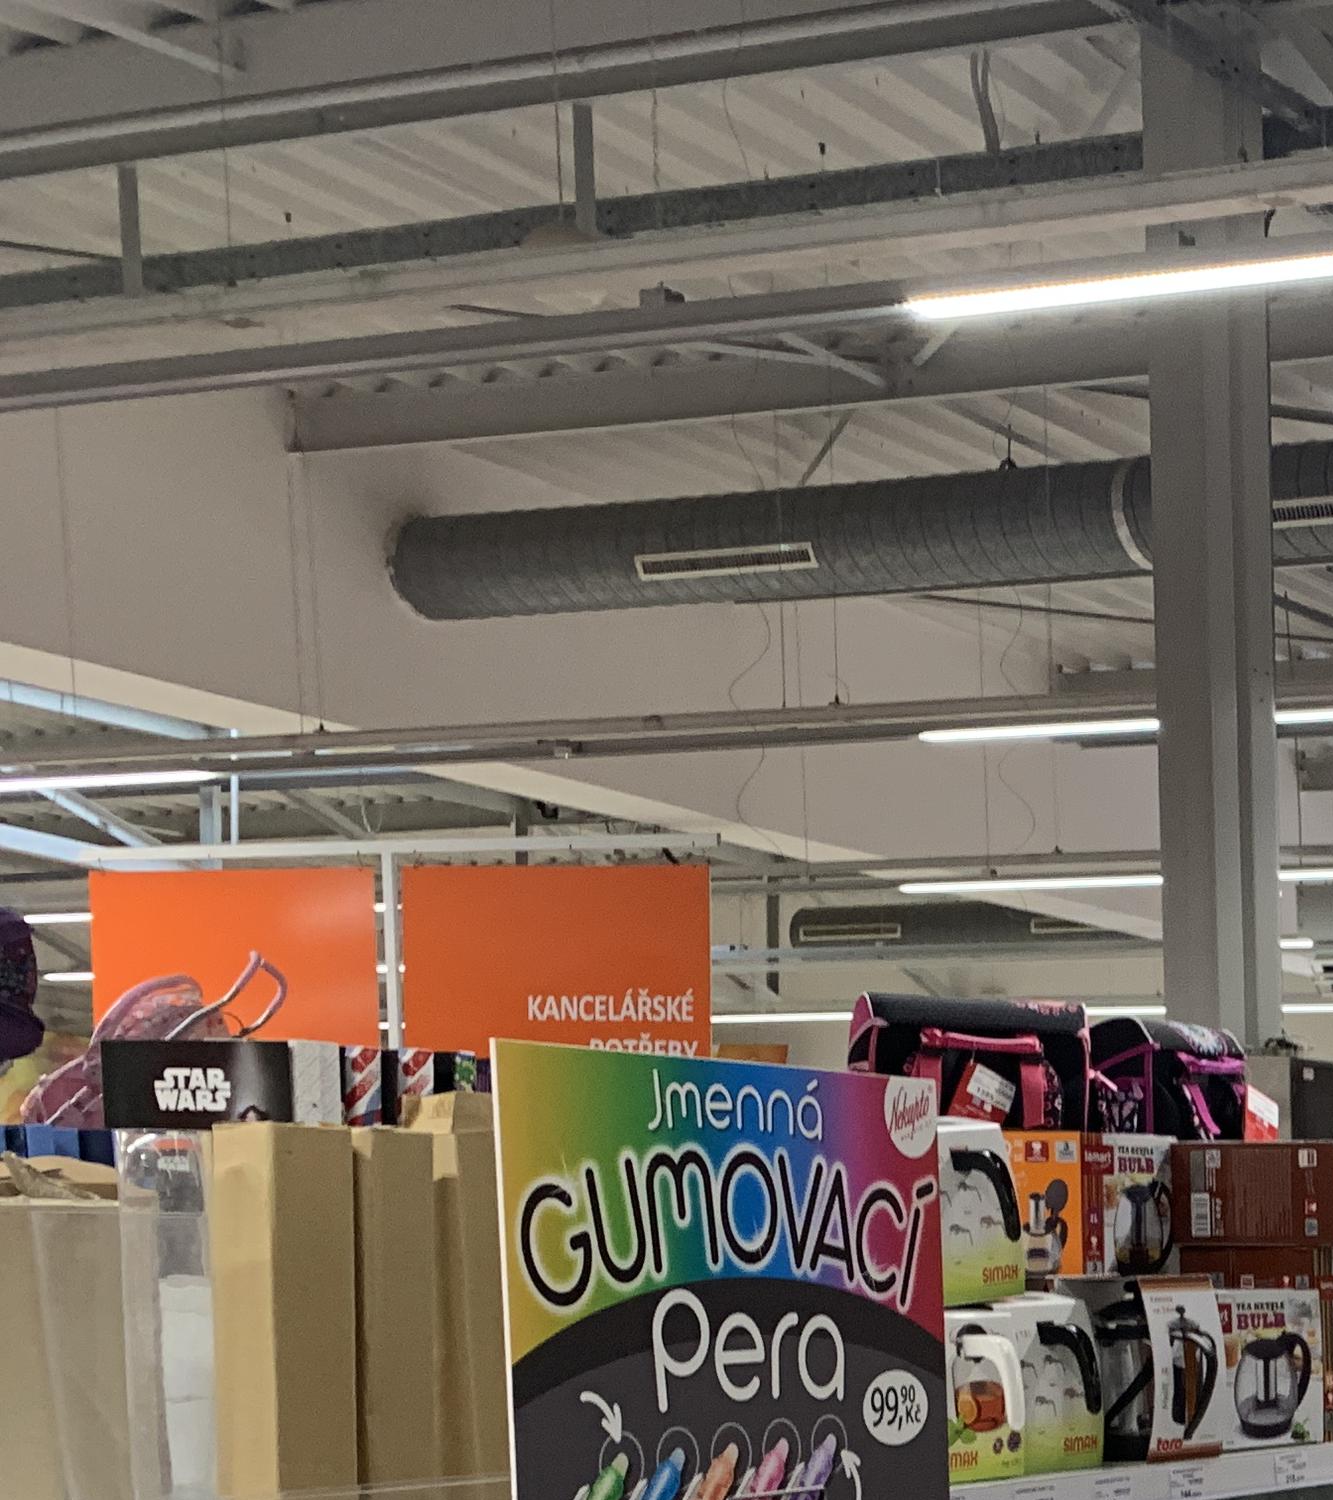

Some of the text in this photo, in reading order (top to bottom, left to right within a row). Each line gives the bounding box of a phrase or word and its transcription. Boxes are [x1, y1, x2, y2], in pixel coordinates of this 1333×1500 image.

[527, 988, 695, 1022] KANCELÁŘSKÉ
[154, 1067, 231, 1089] STAR
[154, 1087, 231, 1112] WARS
[647, 1067, 824, 1143] Jmenná
[1117, 1156, 1155, 1174] BULB
[519, 1146, 937, 1311] GUMOVACÍ
[1236, 1312, 1286, 1330] BULB
[950, 1450, 978, 1468] MAX
